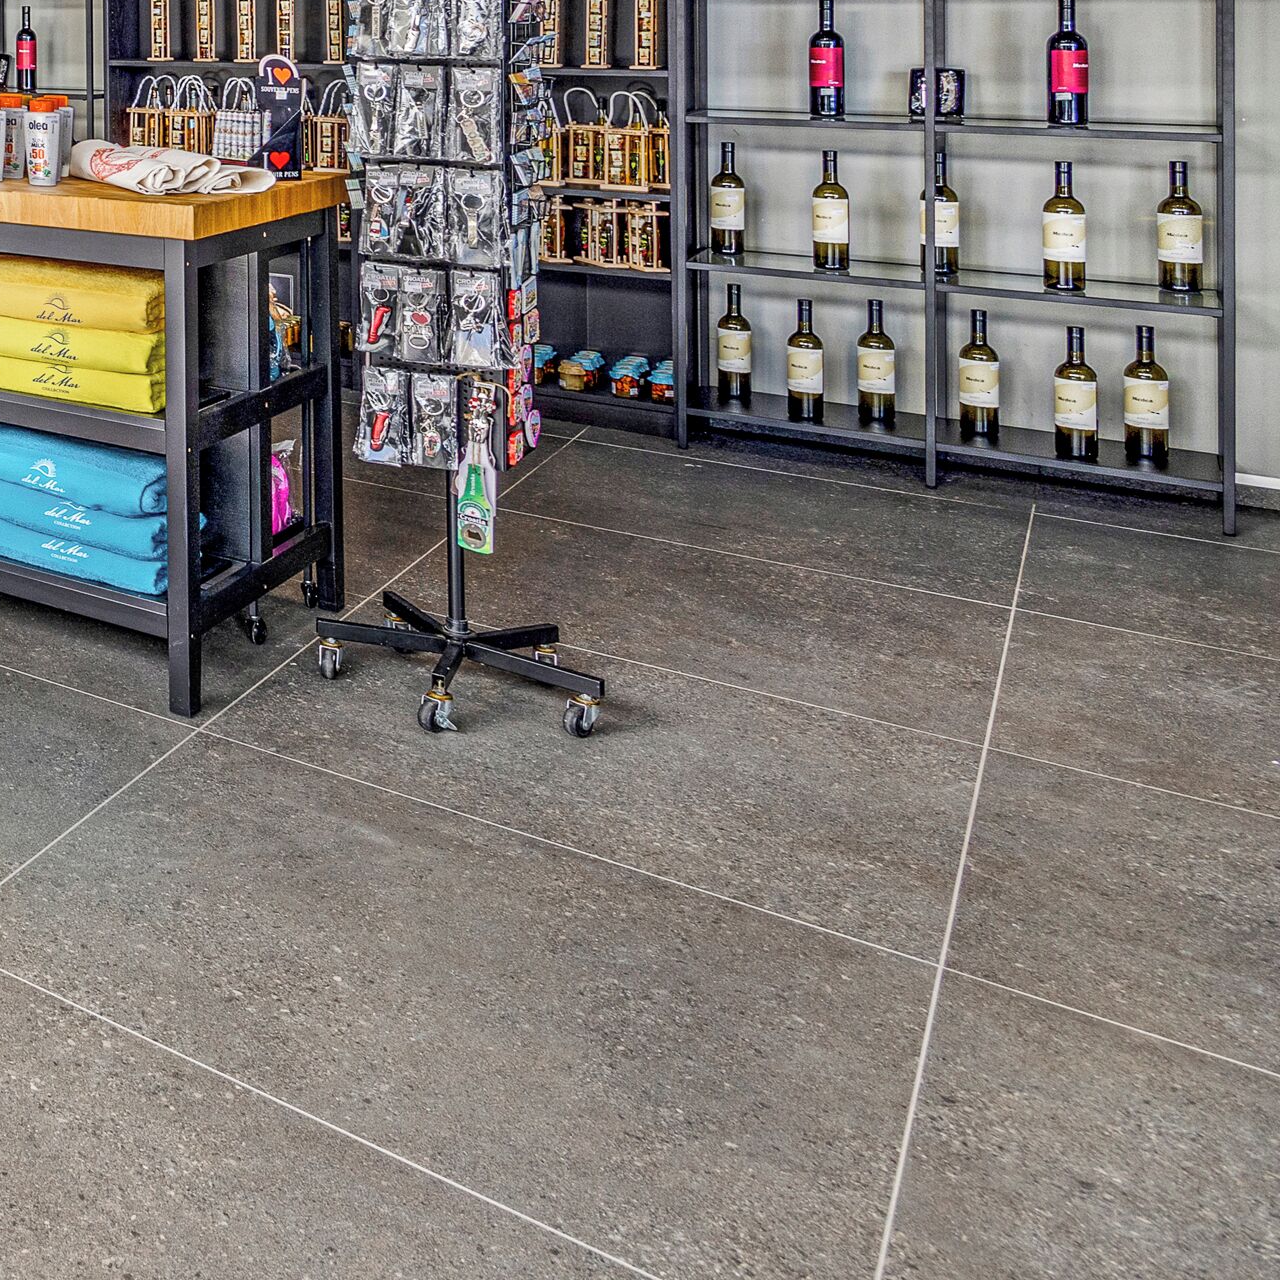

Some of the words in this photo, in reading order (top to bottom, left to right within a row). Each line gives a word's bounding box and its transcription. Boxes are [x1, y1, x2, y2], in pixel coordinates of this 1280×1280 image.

[266, 67, 273, 85] I
[28, 120, 48, 130] olea
[32, 148, 45, 159] 50
[37, 310, 54, 321] del
[55, 312, 82, 324] Mar
[30, 342, 49, 354] del
[49, 348, 78, 361] Mar
[32, 373, 51, 384] del
[51, 376, 81, 389] Mar
[21, 473, 39, 485] del
[38, 478, 67, 493] Mar
[44, 506, 62, 518] del
[62, 510, 93, 526] Mar
[41, 538, 60, 551] del
[60, 544, 90, 559] Mar
